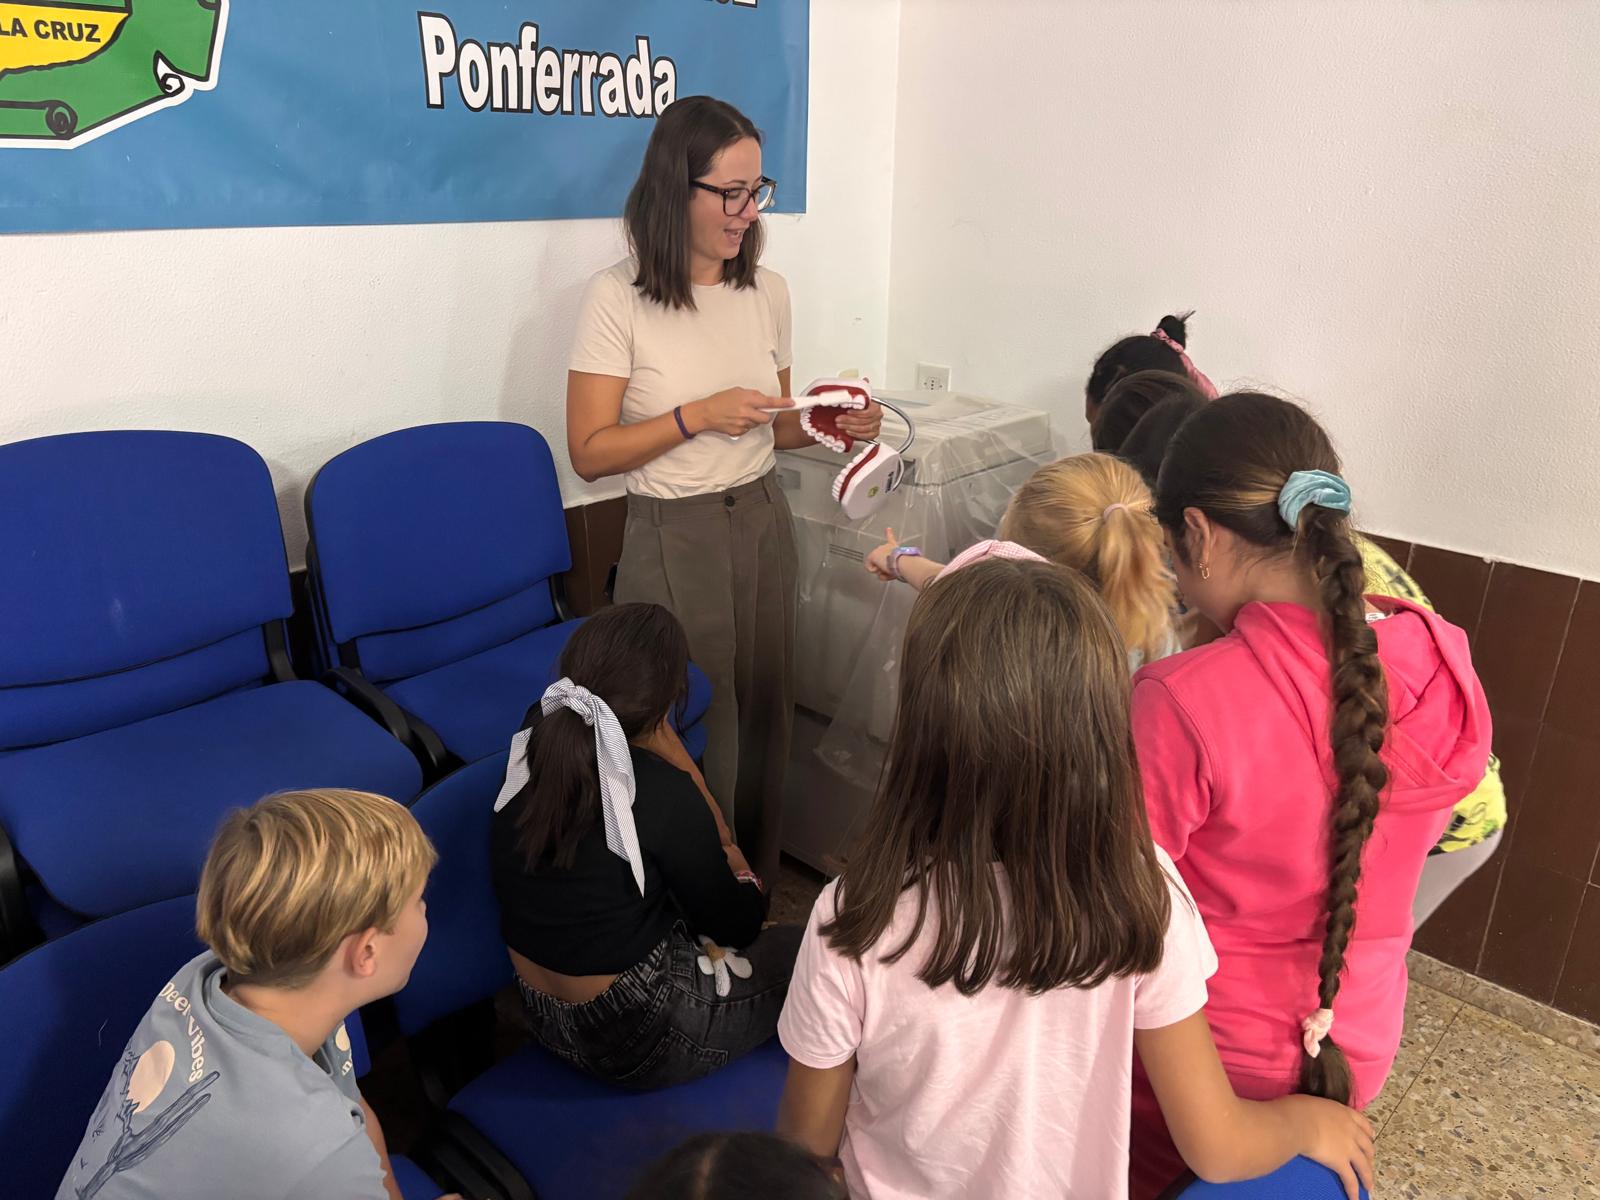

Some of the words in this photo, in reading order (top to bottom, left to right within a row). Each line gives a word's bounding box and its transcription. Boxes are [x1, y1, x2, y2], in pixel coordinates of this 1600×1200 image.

[0, 17, 28, 38] LA
[34, 19, 102, 43] CRUZ
[417, 11, 677, 118] Ponferrada
